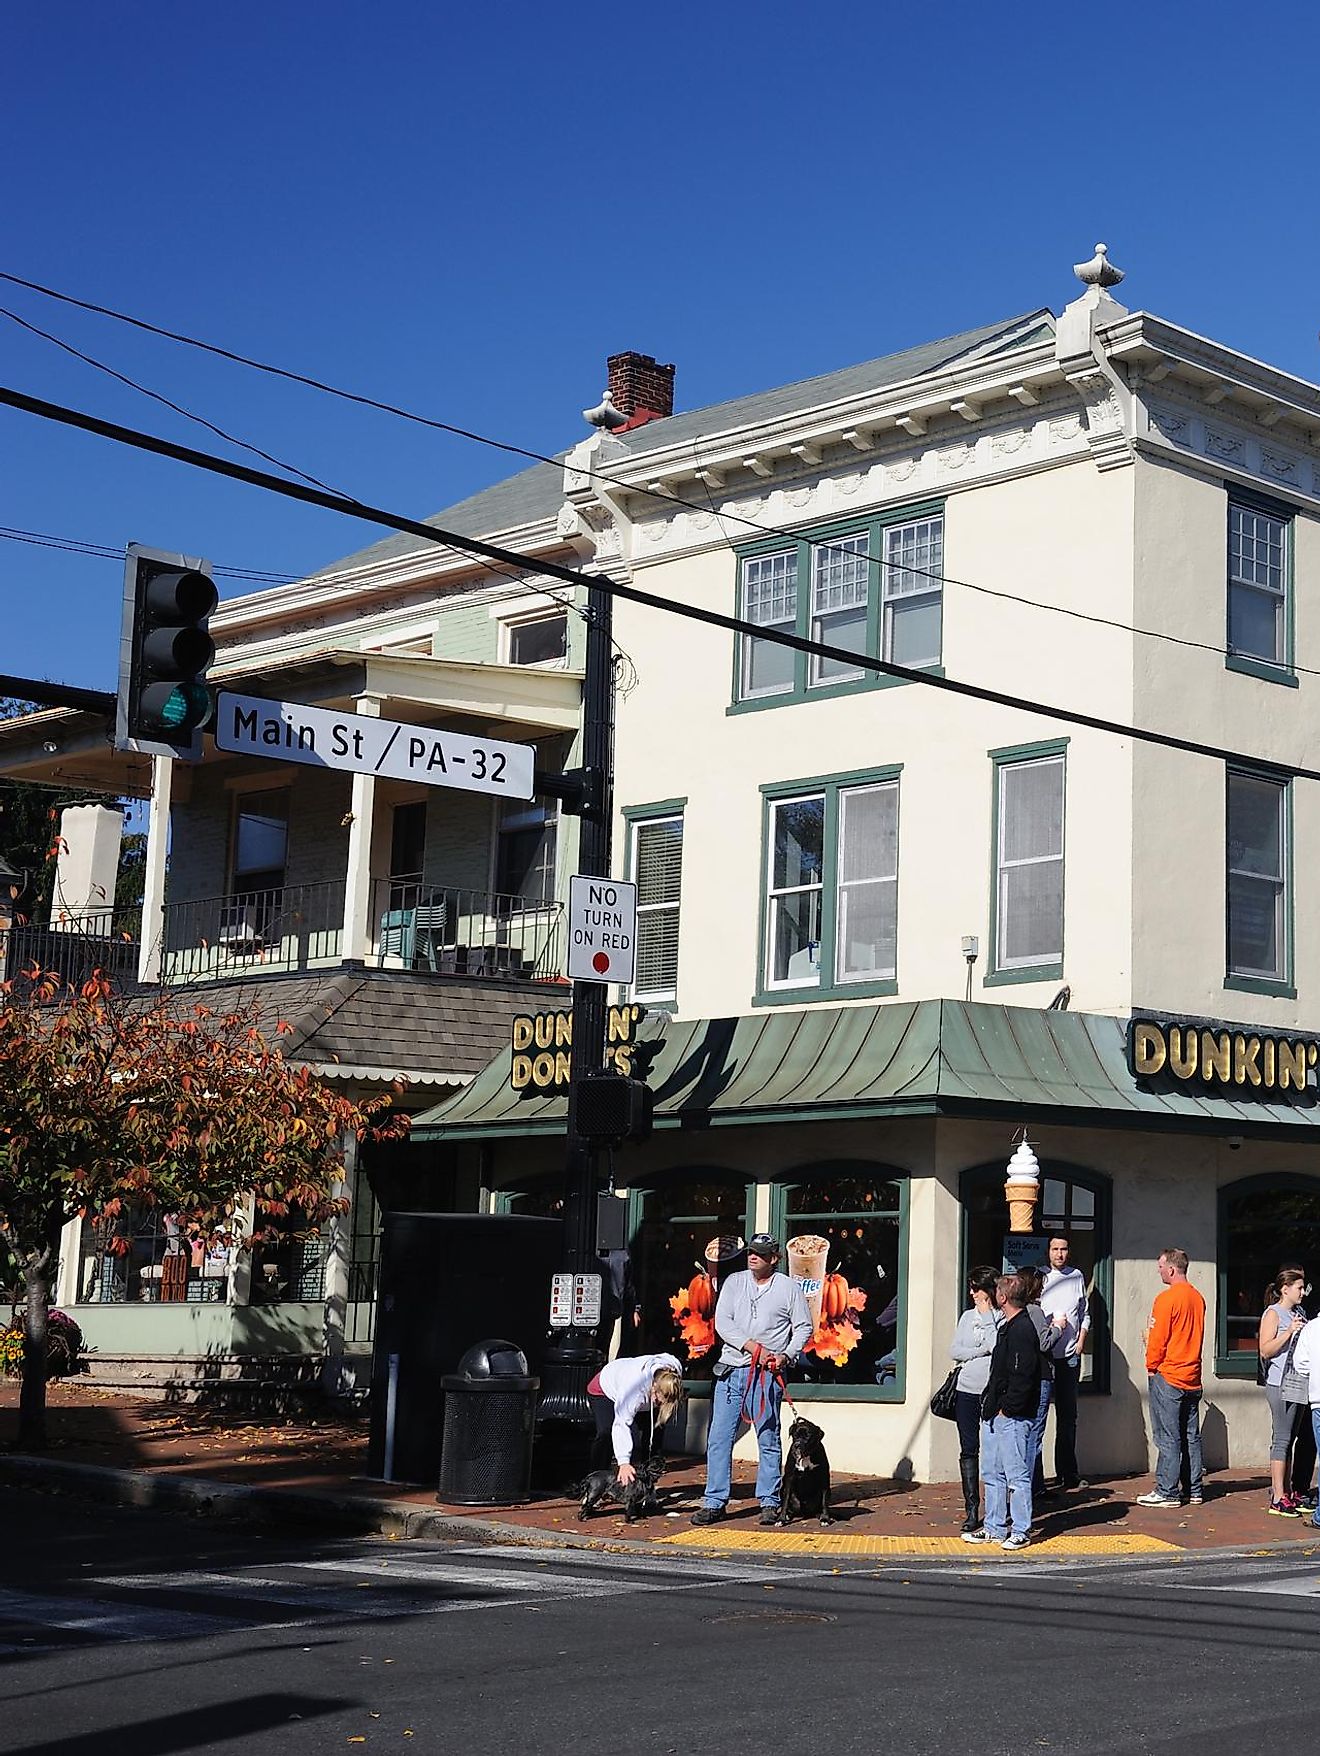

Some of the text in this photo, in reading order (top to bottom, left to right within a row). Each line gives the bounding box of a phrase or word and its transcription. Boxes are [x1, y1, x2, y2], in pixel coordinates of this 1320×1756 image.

[233, 706, 506, 784] Main St / PA-32
[589, 885, 617, 907] NO
[584, 909, 622, 929] TURN
[574, 929, 630, 950] ON RED
[513, 1006, 639, 1050] DUNN'
[1134, 1024, 1318, 1091] DUNKIN'
